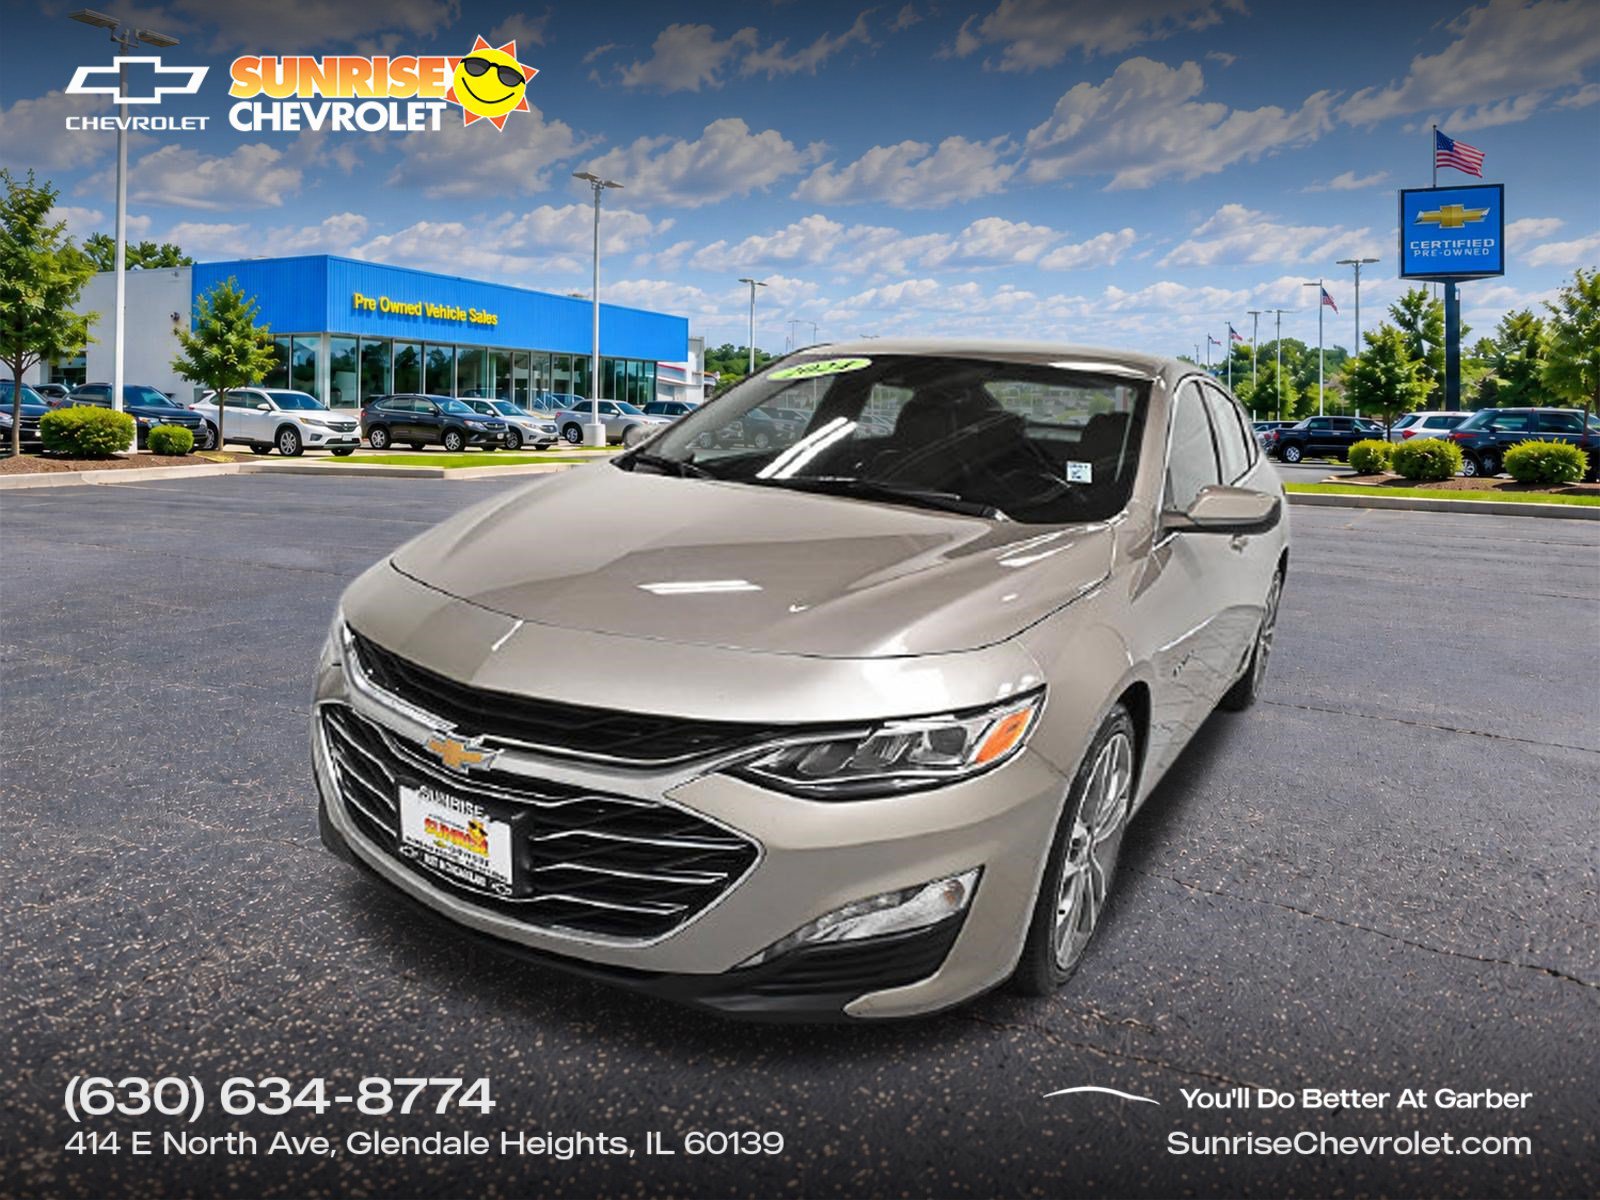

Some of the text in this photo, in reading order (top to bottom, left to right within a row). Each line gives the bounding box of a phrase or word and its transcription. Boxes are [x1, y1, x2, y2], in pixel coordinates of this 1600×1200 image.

[1410, 238, 1495, 250] CERTIFIED
[1413, 247, 1490, 257] PRE-OWNED
[353, 293, 498, 325] Pre Owned Vehicle Sales
